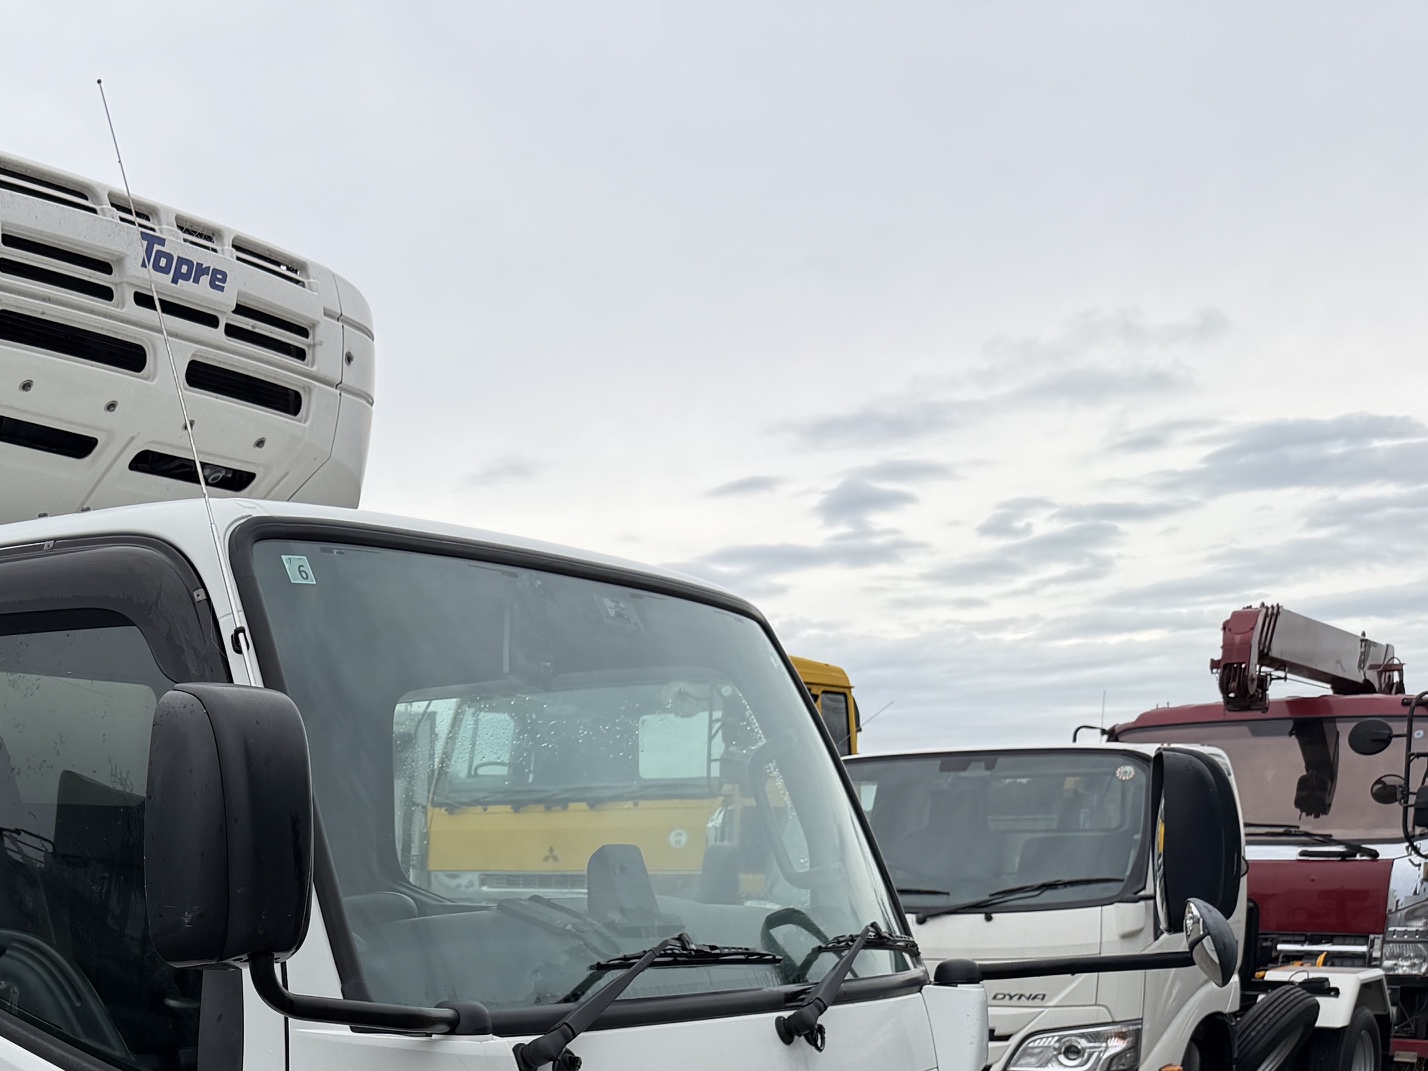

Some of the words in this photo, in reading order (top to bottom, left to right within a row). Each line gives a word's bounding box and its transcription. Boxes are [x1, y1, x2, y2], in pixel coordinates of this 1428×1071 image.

[140, 231, 228, 292] Topre
[297, 564, 310, 581] 6
[991, 992, 1047, 1002] DYNA
